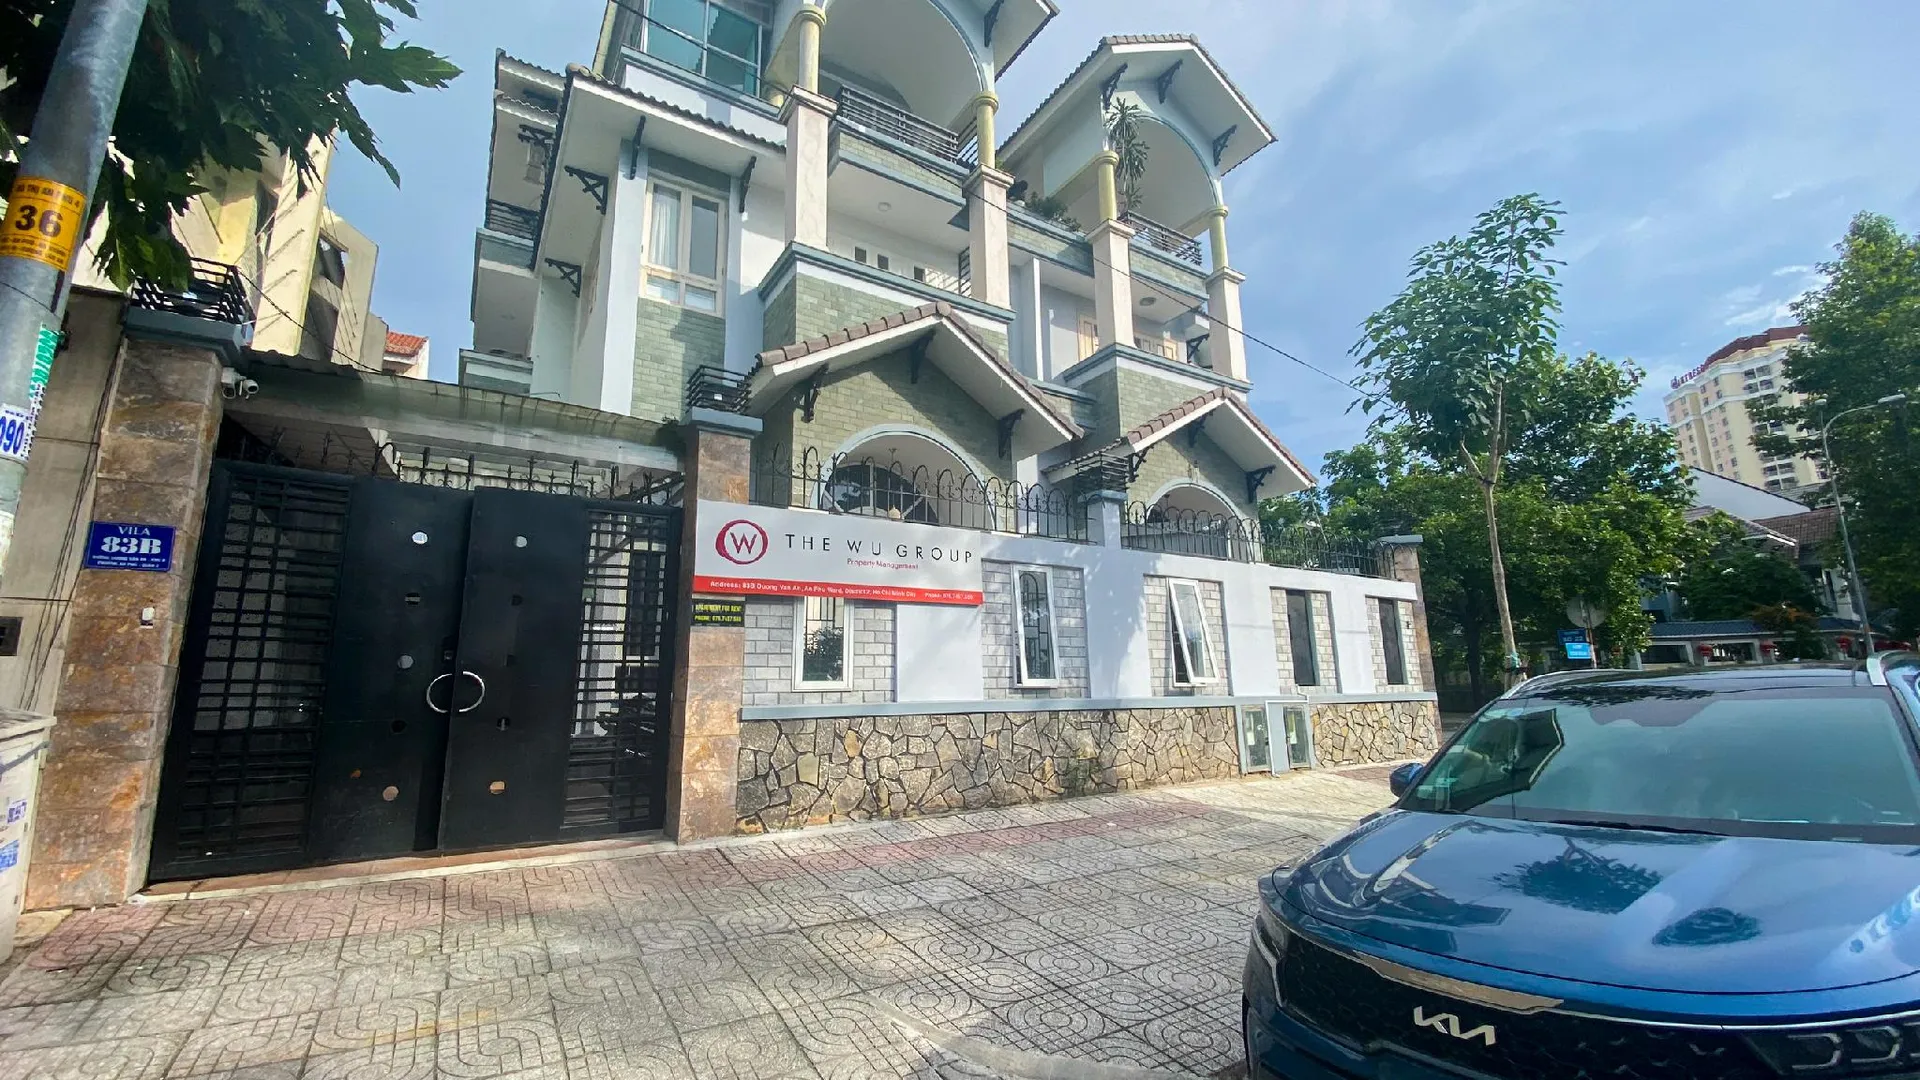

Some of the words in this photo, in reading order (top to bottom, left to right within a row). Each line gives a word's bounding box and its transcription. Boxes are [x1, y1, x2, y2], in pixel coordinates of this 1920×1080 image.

[15, 204, 63, 238] 36
[118, 526, 151, 536] VILA
[101, 536, 162, 554] 83B
[729, 531, 758, 555] W
[785, 533, 830, 551] THE
[846, 540, 881, 556] WU
[896, 544, 972, 563] GROUP
[847, 558, 875, 569] Property
[710, 581, 741, 589] Address:
[757, 583, 778, 591] Duong
[1413, 1005, 1497, 1046] KIA
